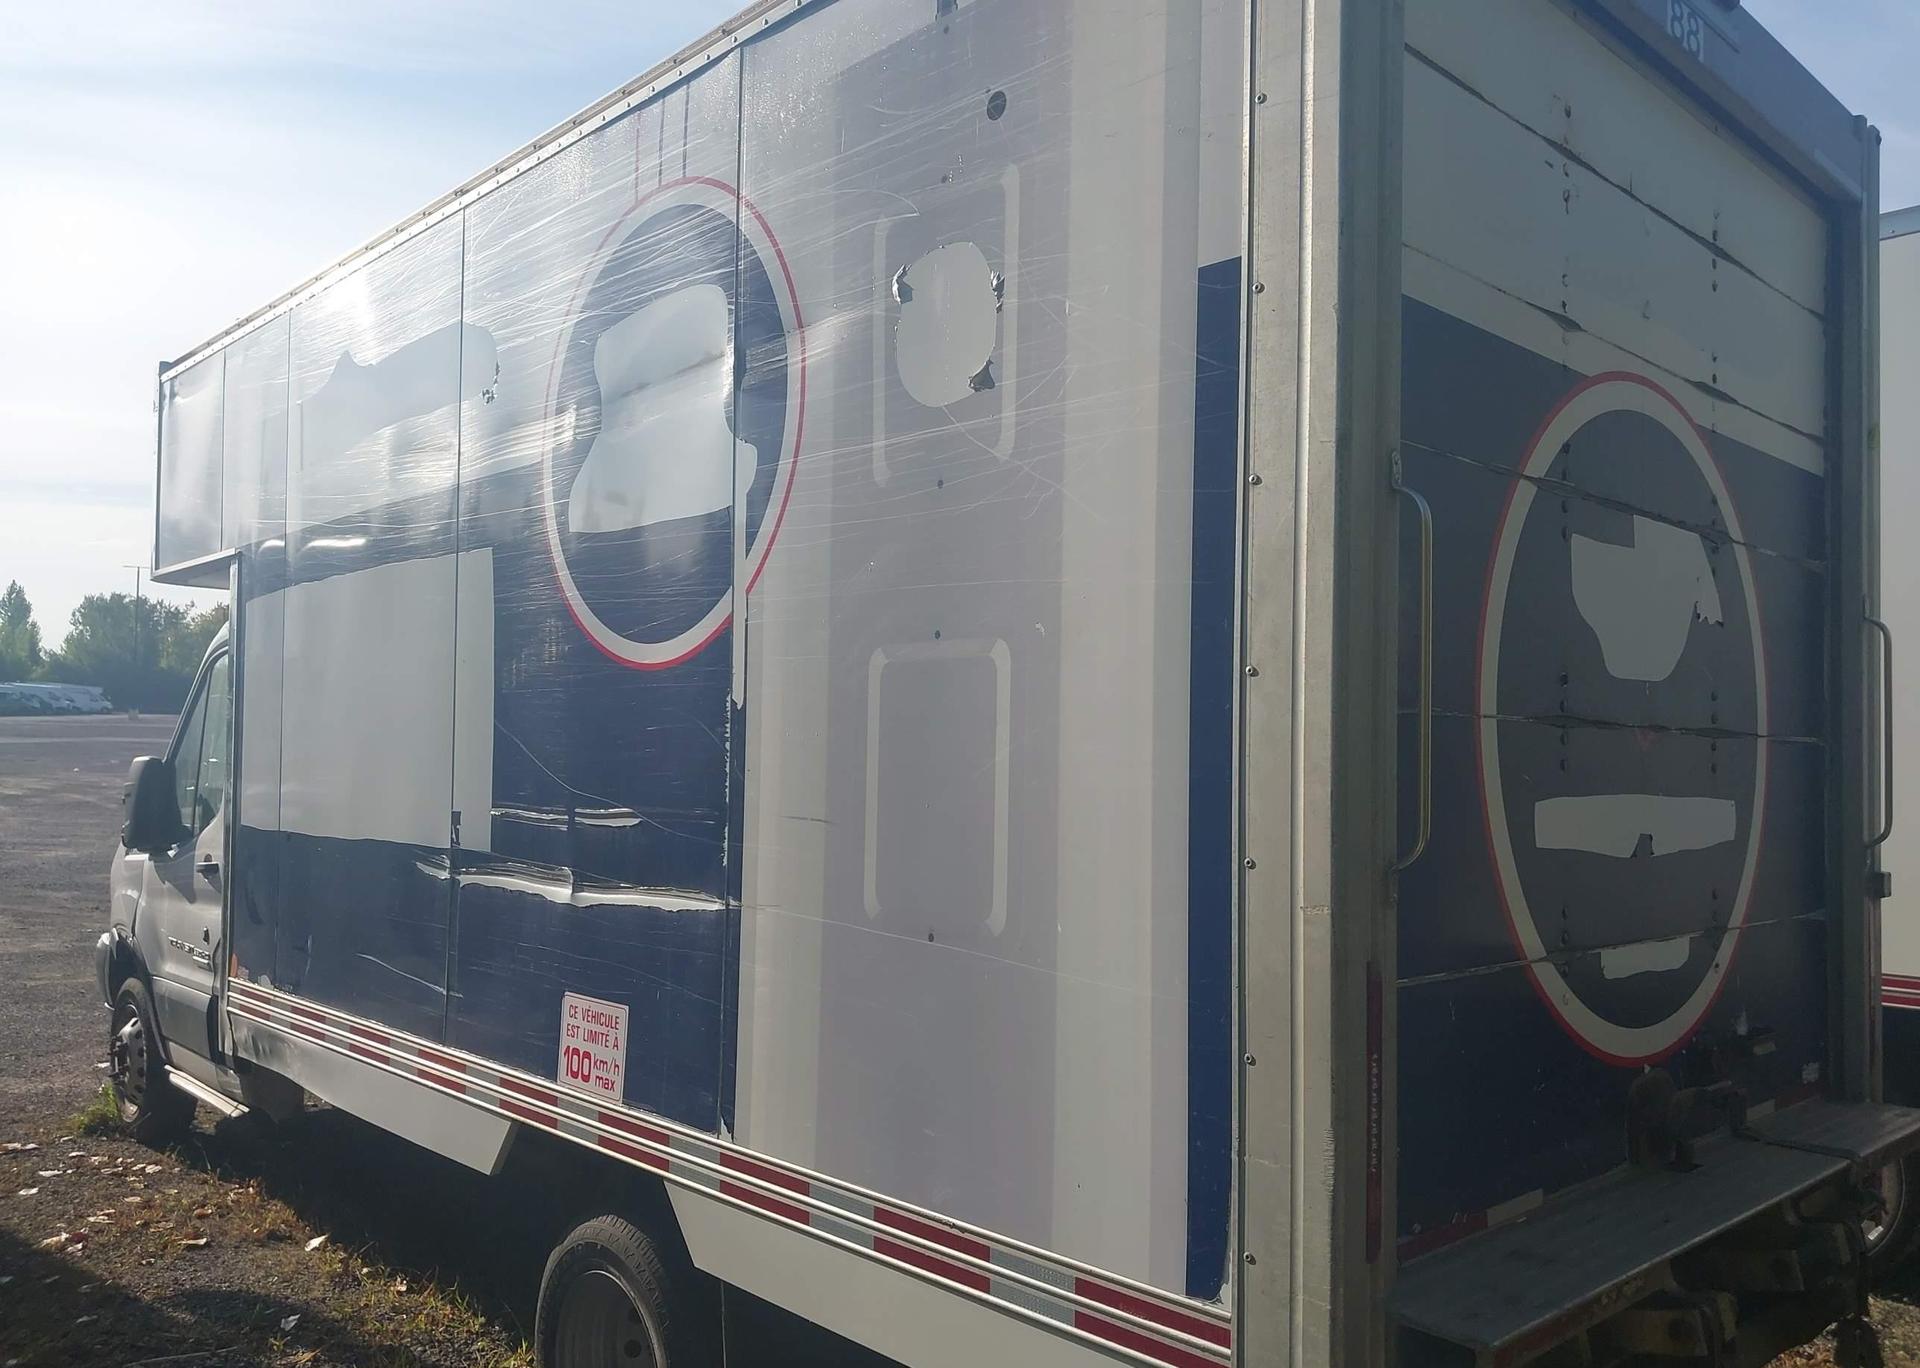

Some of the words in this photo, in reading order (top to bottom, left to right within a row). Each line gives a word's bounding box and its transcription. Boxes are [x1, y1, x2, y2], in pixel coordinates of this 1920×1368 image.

[569, 1004, 578, 1020] CE
[581, 1005, 620, 1030] VÉHICULE
[566, 1023, 580, 1039] EST
[583, 1028, 609, 1048] LIMITÉ
[612, 1032, 619, 1051] À
[563, 1045, 592, 1083] 100
[593, 1053, 620, 1076] km/h
[595, 1075, 615, 1092] max
